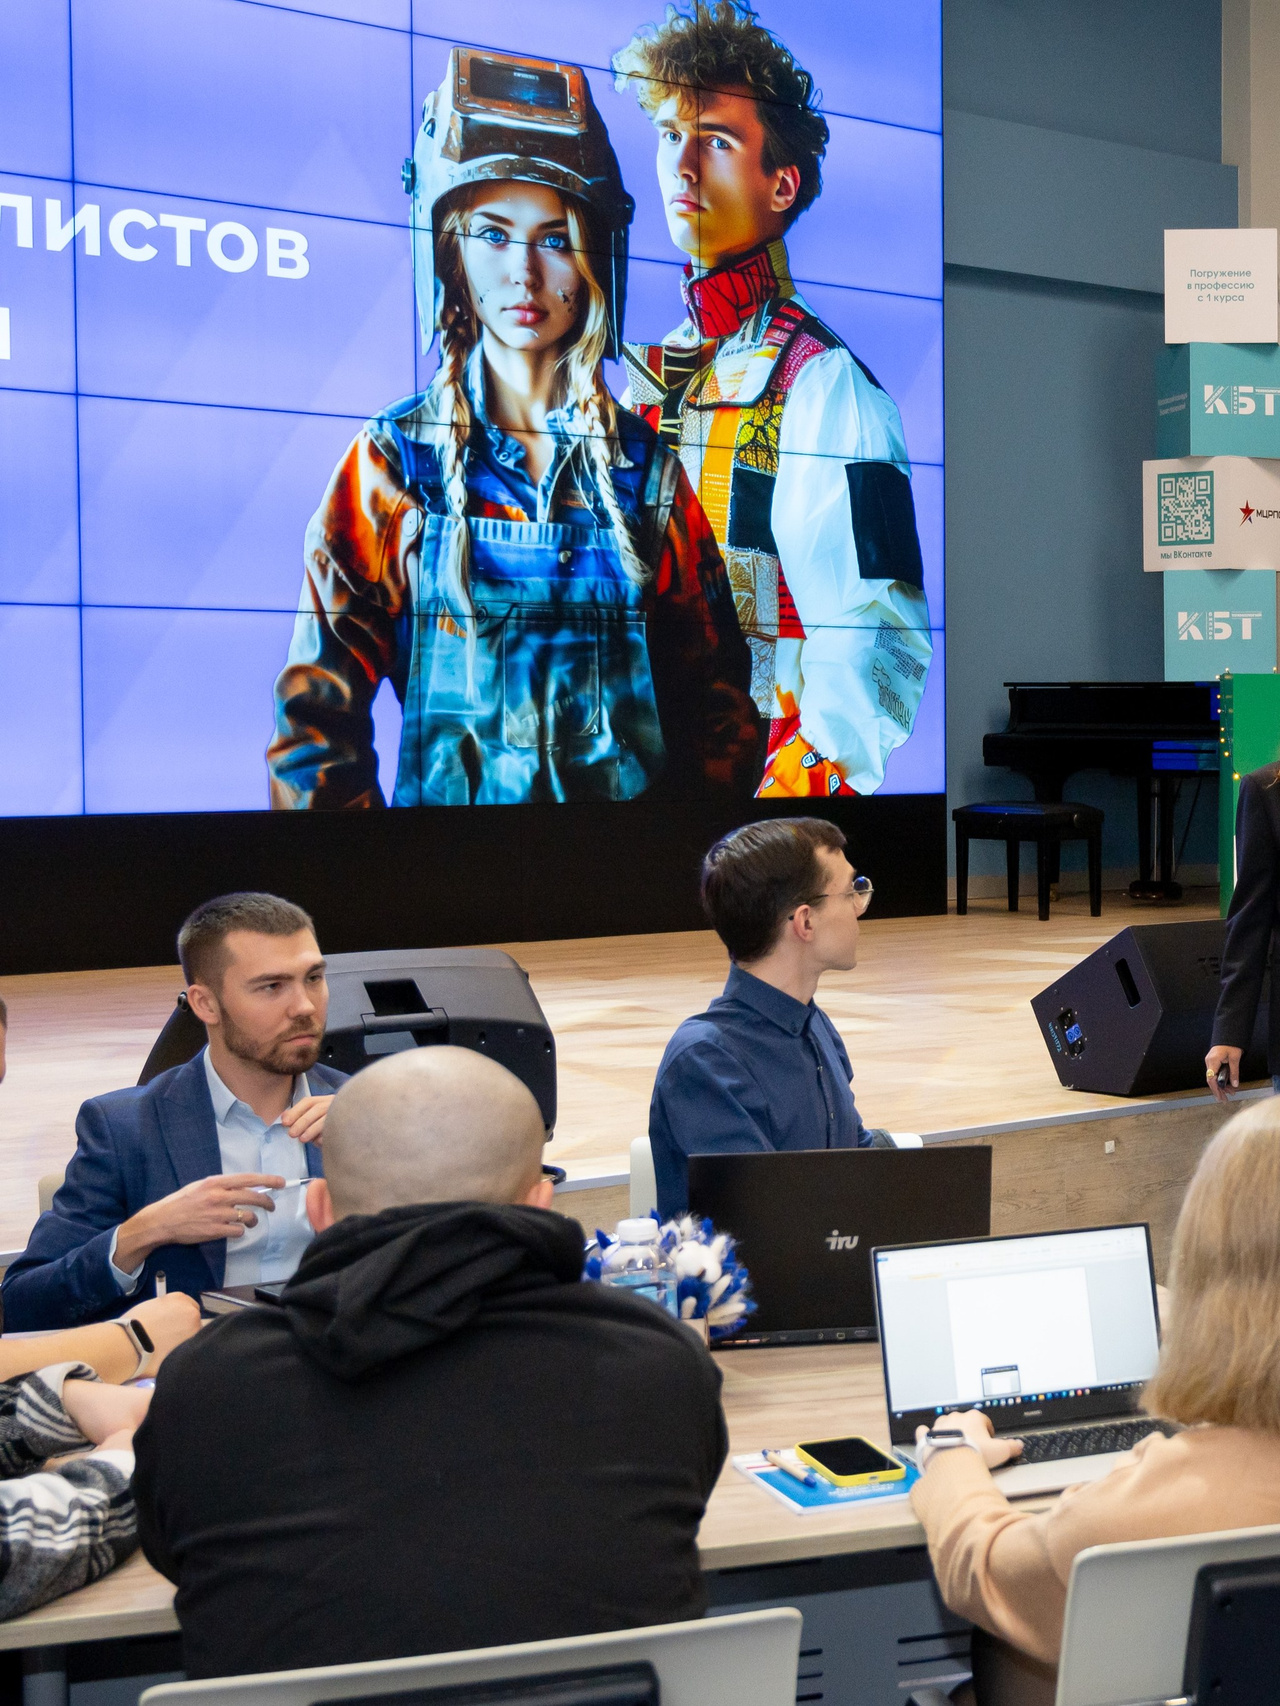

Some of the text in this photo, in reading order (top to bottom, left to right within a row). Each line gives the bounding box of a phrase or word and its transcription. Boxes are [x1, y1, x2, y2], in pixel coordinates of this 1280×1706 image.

[1190, 269, 1252, 278] Погружение
[1194, 282, 1255, 291] профессию
[1197, 294, 1245, 303] с 1 курса
[1160, 550, 1213, 560] мы ВКонтакте
[825, 1229, 859, 1250] iru
